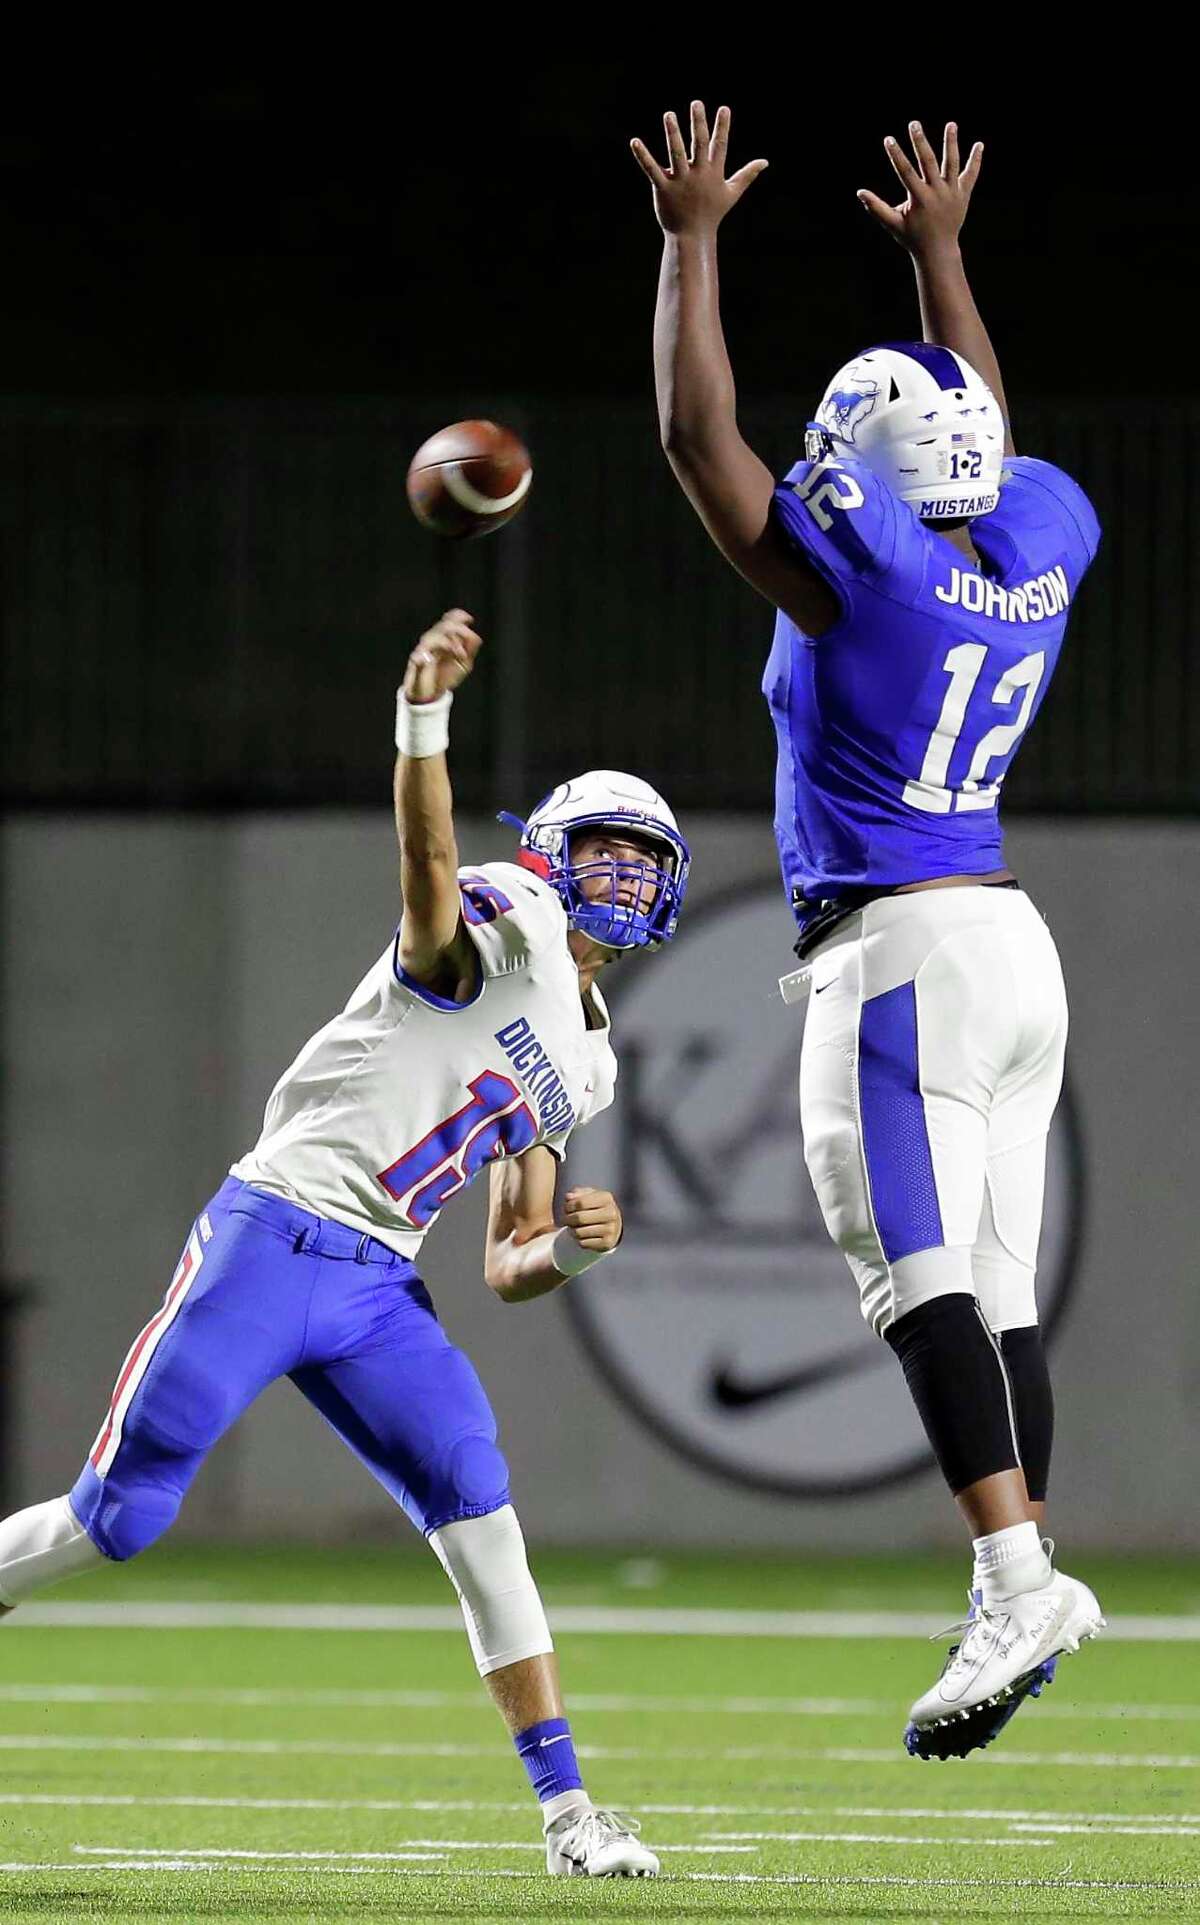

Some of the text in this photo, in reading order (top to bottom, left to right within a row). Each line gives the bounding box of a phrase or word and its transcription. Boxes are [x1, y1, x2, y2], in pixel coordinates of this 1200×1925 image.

[792, 453, 865, 532] 12
[919, 494, 995, 516] MUSTANGS
[935, 565, 1071, 623] JOHNSON
[901, 642, 1045, 814] 12
[494, 1016, 576, 1135] DICKINSON
[376, 1068, 539, 1228] 15
